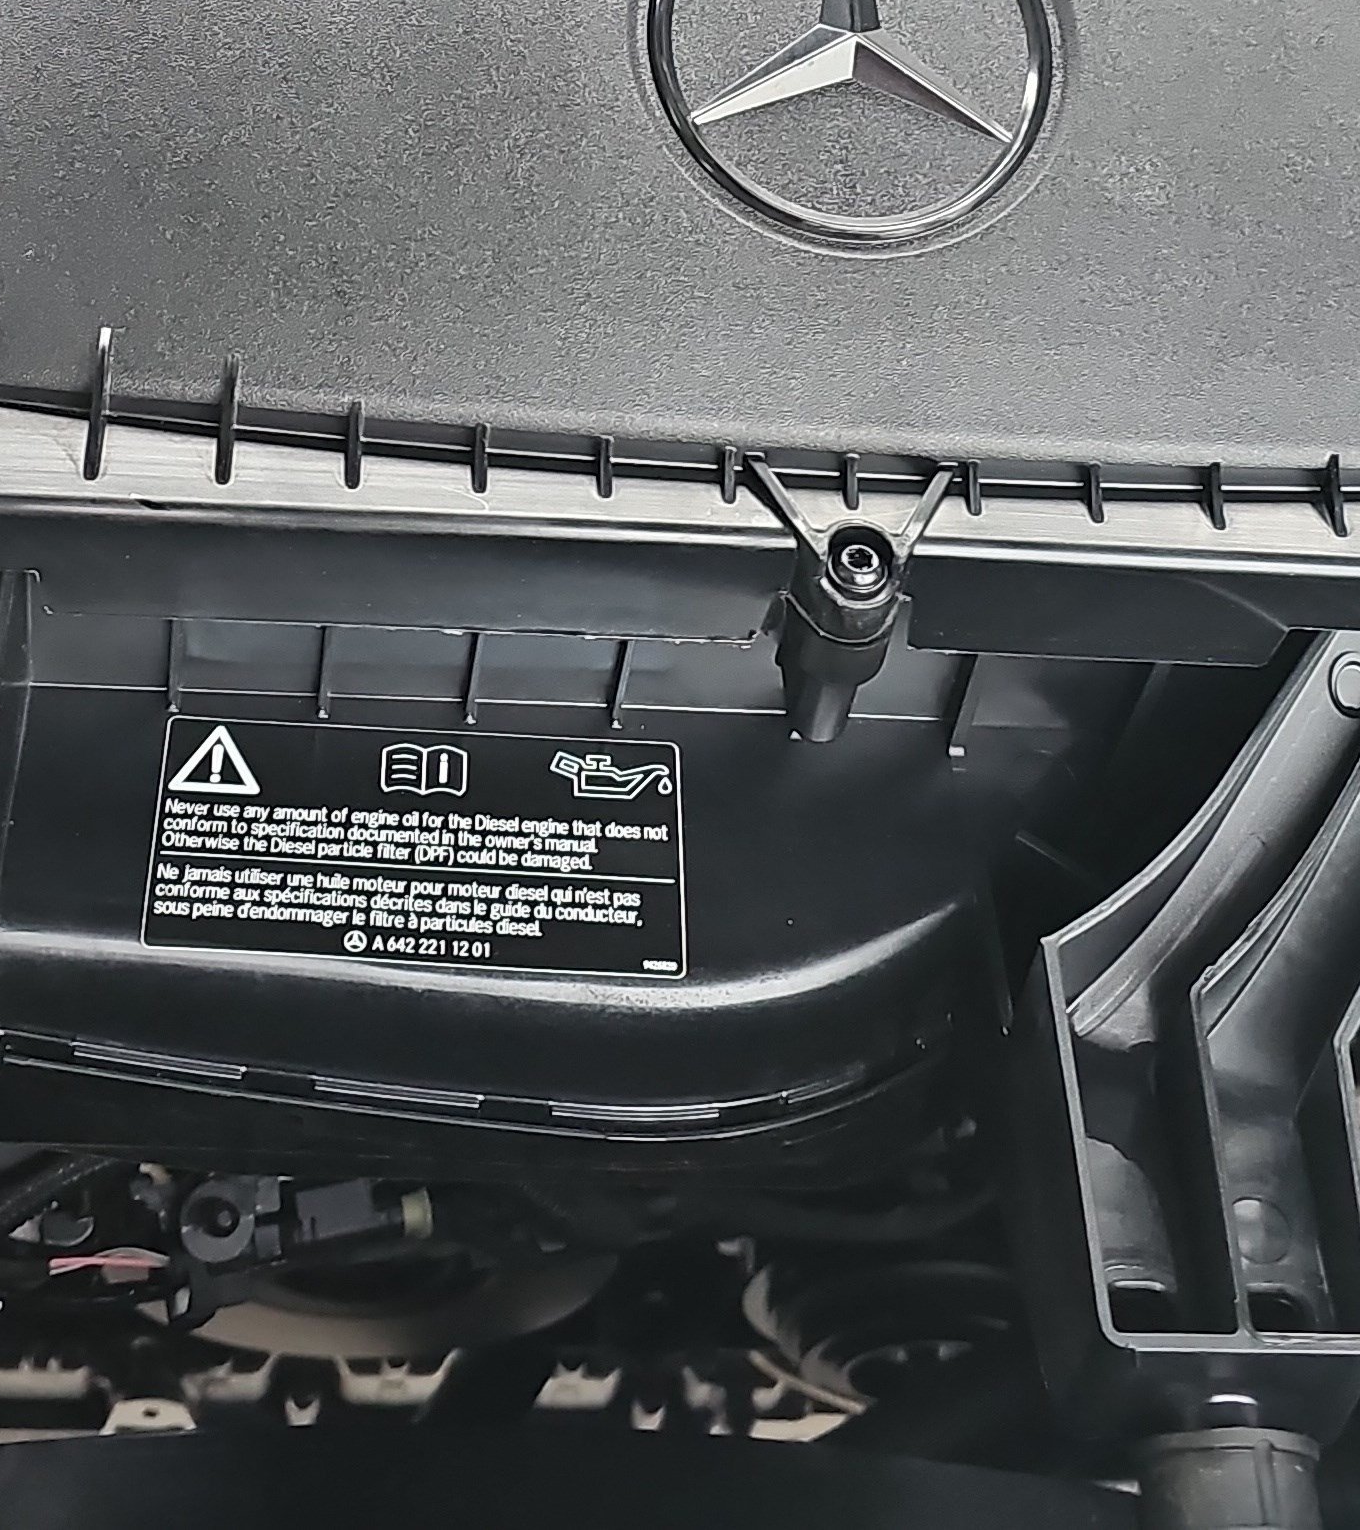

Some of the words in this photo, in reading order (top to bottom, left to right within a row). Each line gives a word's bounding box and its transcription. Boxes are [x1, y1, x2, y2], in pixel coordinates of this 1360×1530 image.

[162, 815, 227, 832] conform
[230, 818, 247, 834] to
[250, 818, 344, 841] specification
[346, 824, 439, 844] documented
[441, 828, 454, 845] in
[457, 830, 482, 846] the
[484, 833, 542, 850] owner's
[544, 834, 598, 853] manual.
[164, 797, 210, 815] Never
[212, 803, 240, 817] use
[242, 805, 269, 822] any
[272, 806, 327, 822] amount
[330, 807, 347, 822] of
[350, 809, 399, 828] engine
[401, 811, 419, 826] oil
[421, 812, 444, 828] for
[447, 813, 471, 829] the
[474, 814, 519, 832] Diesel
[521, 818, 568, 837] engine
[571, 820, 602, 837] that
[604, 822, 641, 839] does
[643, 825, 668, 841] not
[161, 830, 239, 850] Otherwise
[243, 835, 267, 851] the
[269, 836, 315, 854] Diesel
[316, 840, 373, 858] particle
[376, 842, 410, 860] filter
[414, 844, 454, 865] (DPF)
[456, 848, 496, 864] could
[498, 849, 518, 866] be
[520, 850, 592, 872] damaged.
[154, 880, 230, 899] conforme
[232, 887, 259, 901] aux
[262, 886, 367, 910] spécifications
[369, 893, 432, 911] décrites
[434, 896, 471, 913] dans
[473, 898, 487, 914] le
[489, 900, 531, 919] guide
[533, 902, 552, 918] du
[554, 902, 642, 925] conducteur,
[156, 862, 179, 879] Ne
[181, 864, 232, 884] jamais
[234, 867, 284, 885] utiliser
[286, 873, 313, 887] une
[352, 875, 406, 892] moteur
[409, 881, 444, 898] pour
[447, 881, 500, 898] moteur
[504, 883, 548, 901] diesel
[550, 886, 572, 905] qui
[574, 887, 610, 904] n'est
[612, 892, 640, 908] pas
[153, 900, 190, 915] sous
[191, 900, 234, 918] peine
[236, 902, 348, 927] d'endommager
[351, 909, 366, 925] le
[369, 910, 404, 928] filtre
[407, 912, 417, 929] à
[419, 914, 493, 933] particules
[495, 917, 542, 936] diesel.
[371, 935, 384, 951] A
[386, 936, 415, 953] 642
[418, 938, 445, 954] 221
[452, 940, 469, 956] 12
[471, 941, 490, 957] 01
